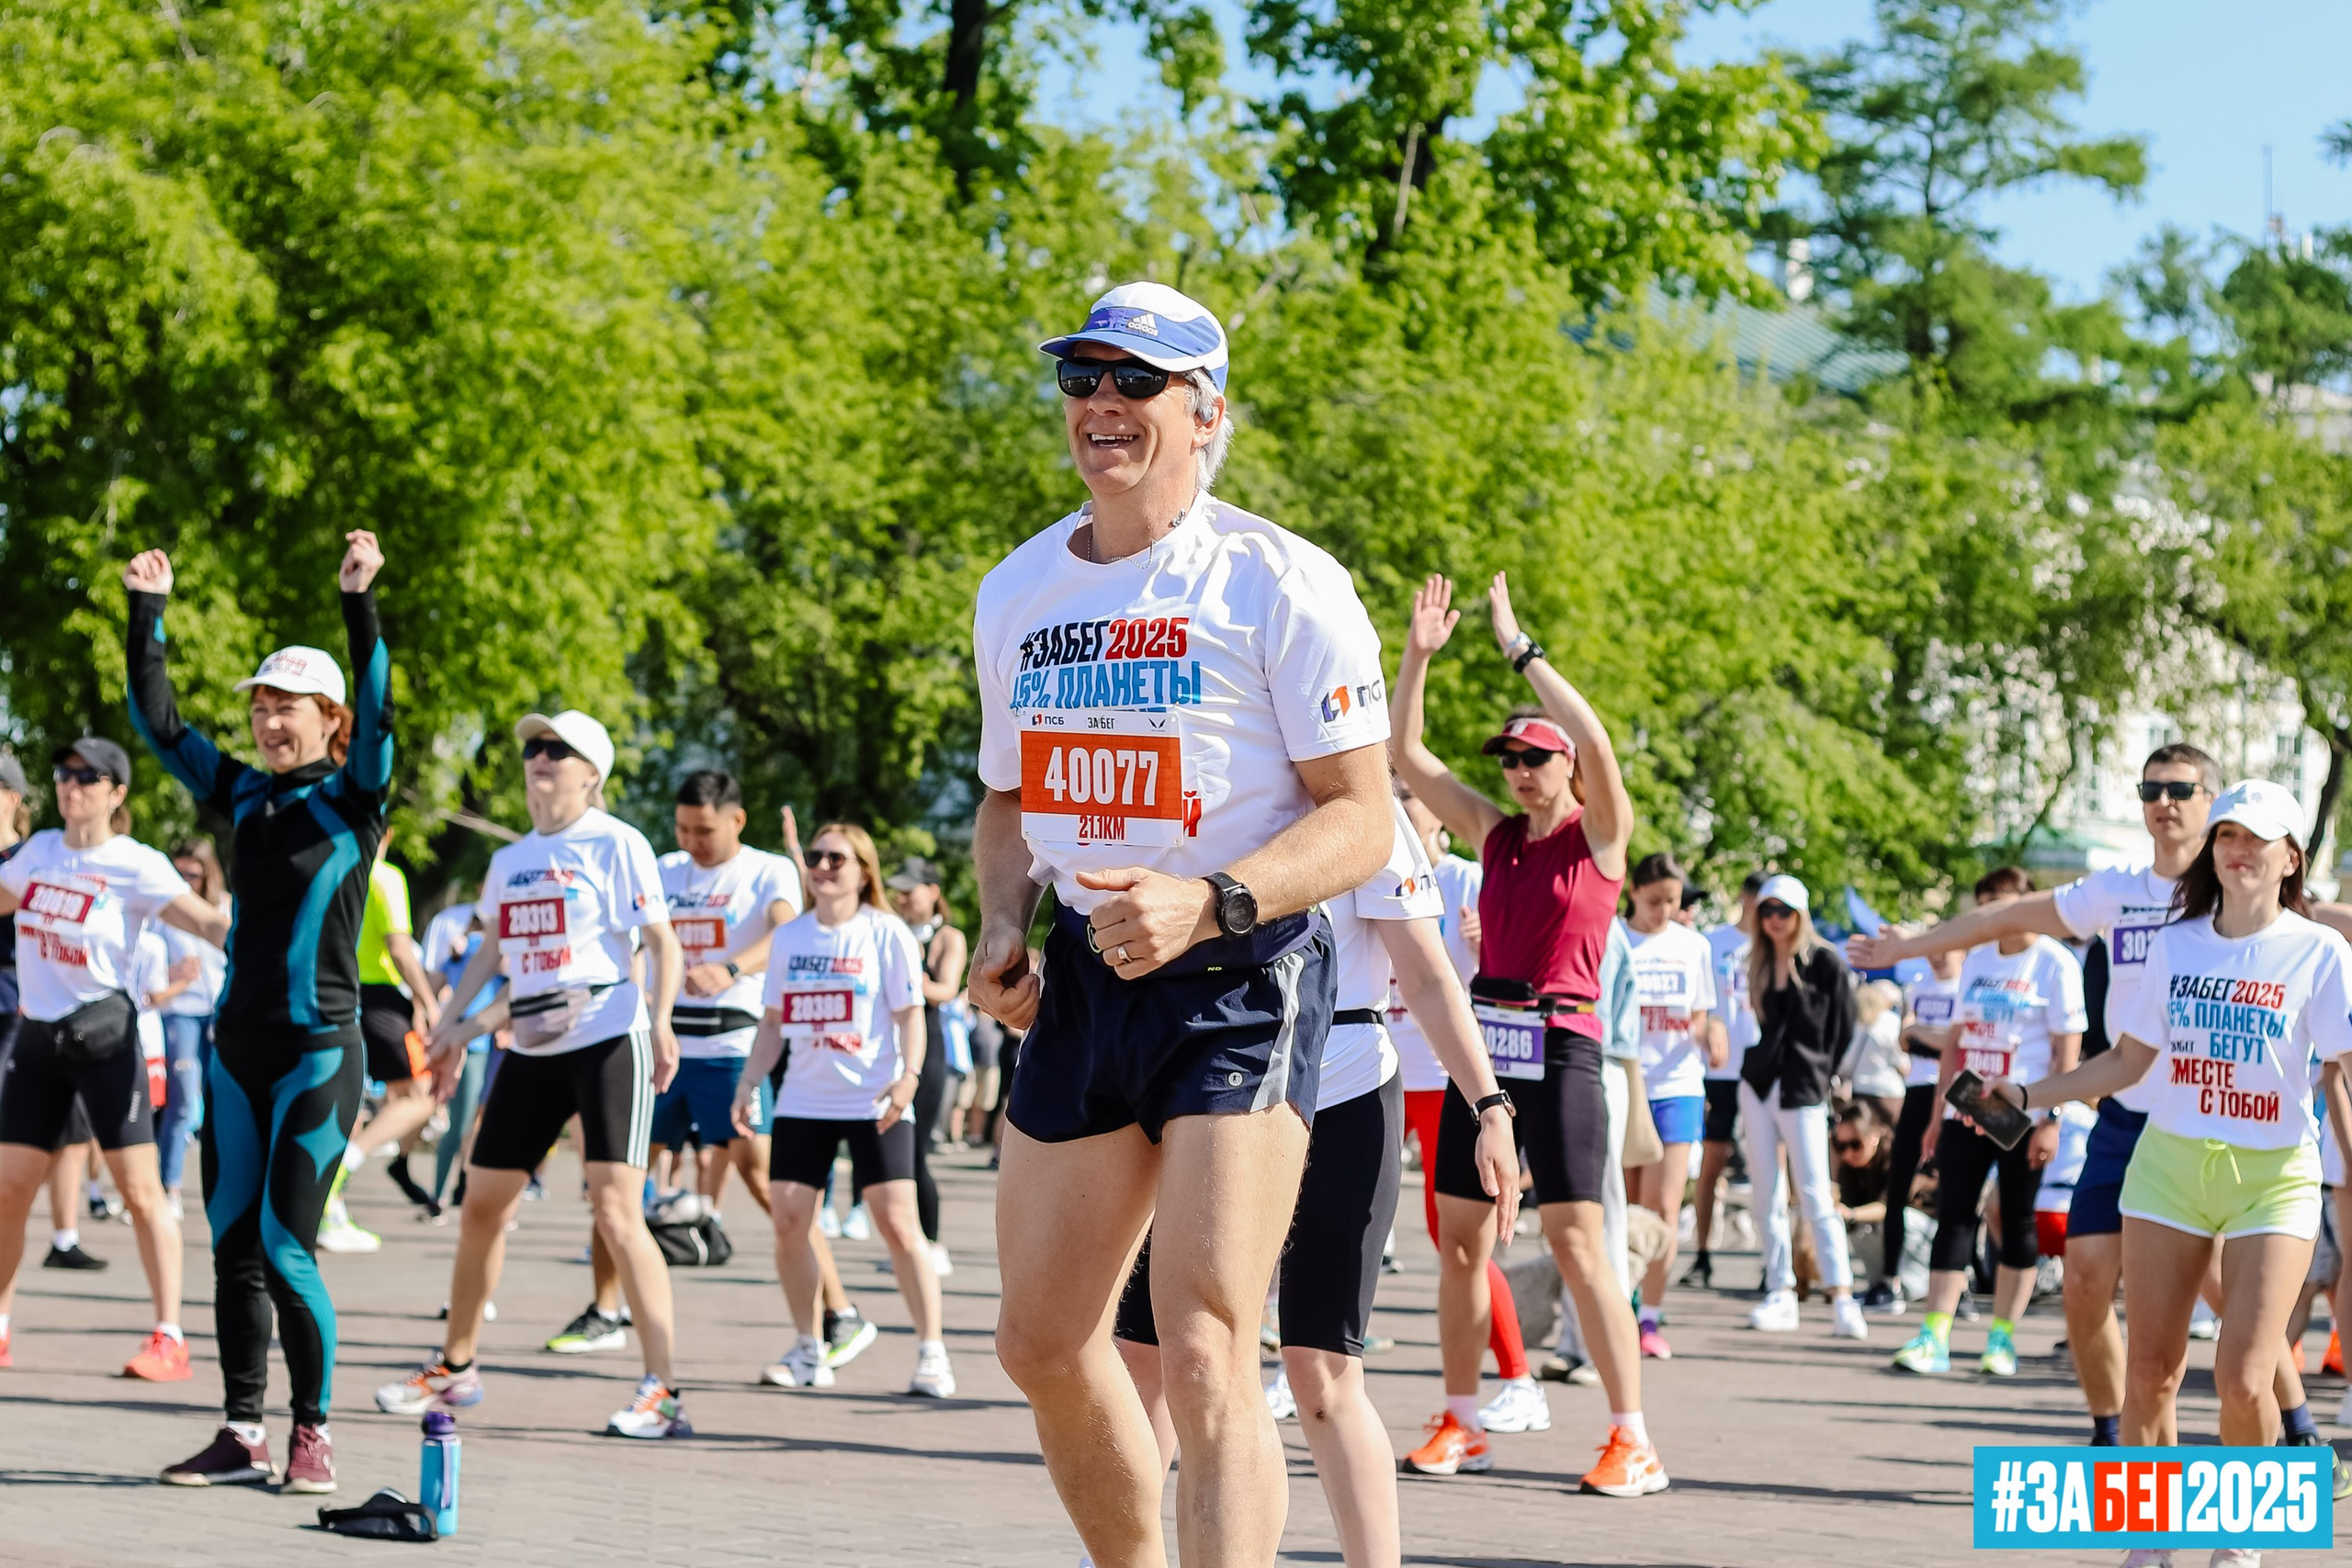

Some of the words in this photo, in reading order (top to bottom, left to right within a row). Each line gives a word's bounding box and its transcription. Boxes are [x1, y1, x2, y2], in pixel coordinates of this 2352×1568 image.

[1127, 321, 1159, 336] adidas
[1019, 616, 1190, 672] #ЗАБЕГ2025
[1057, 660, 1202, 709] ПЛАНЕТЫ
[1045, 716, 1064, 726] ПСБ
[1044, 746, 1159, 807] 40077
[2170, 975, 2286, 1009] #ЗАБЕГ2025
[2195, 1003, 2287, 1039] ПЛАНЕТЫ
[2210, 1032, 2265, 1065] БЕГУТ
[2200, 1089, 2213, 1114] С
[2219, 1090, 2280, 1122] ТОБОЙ
